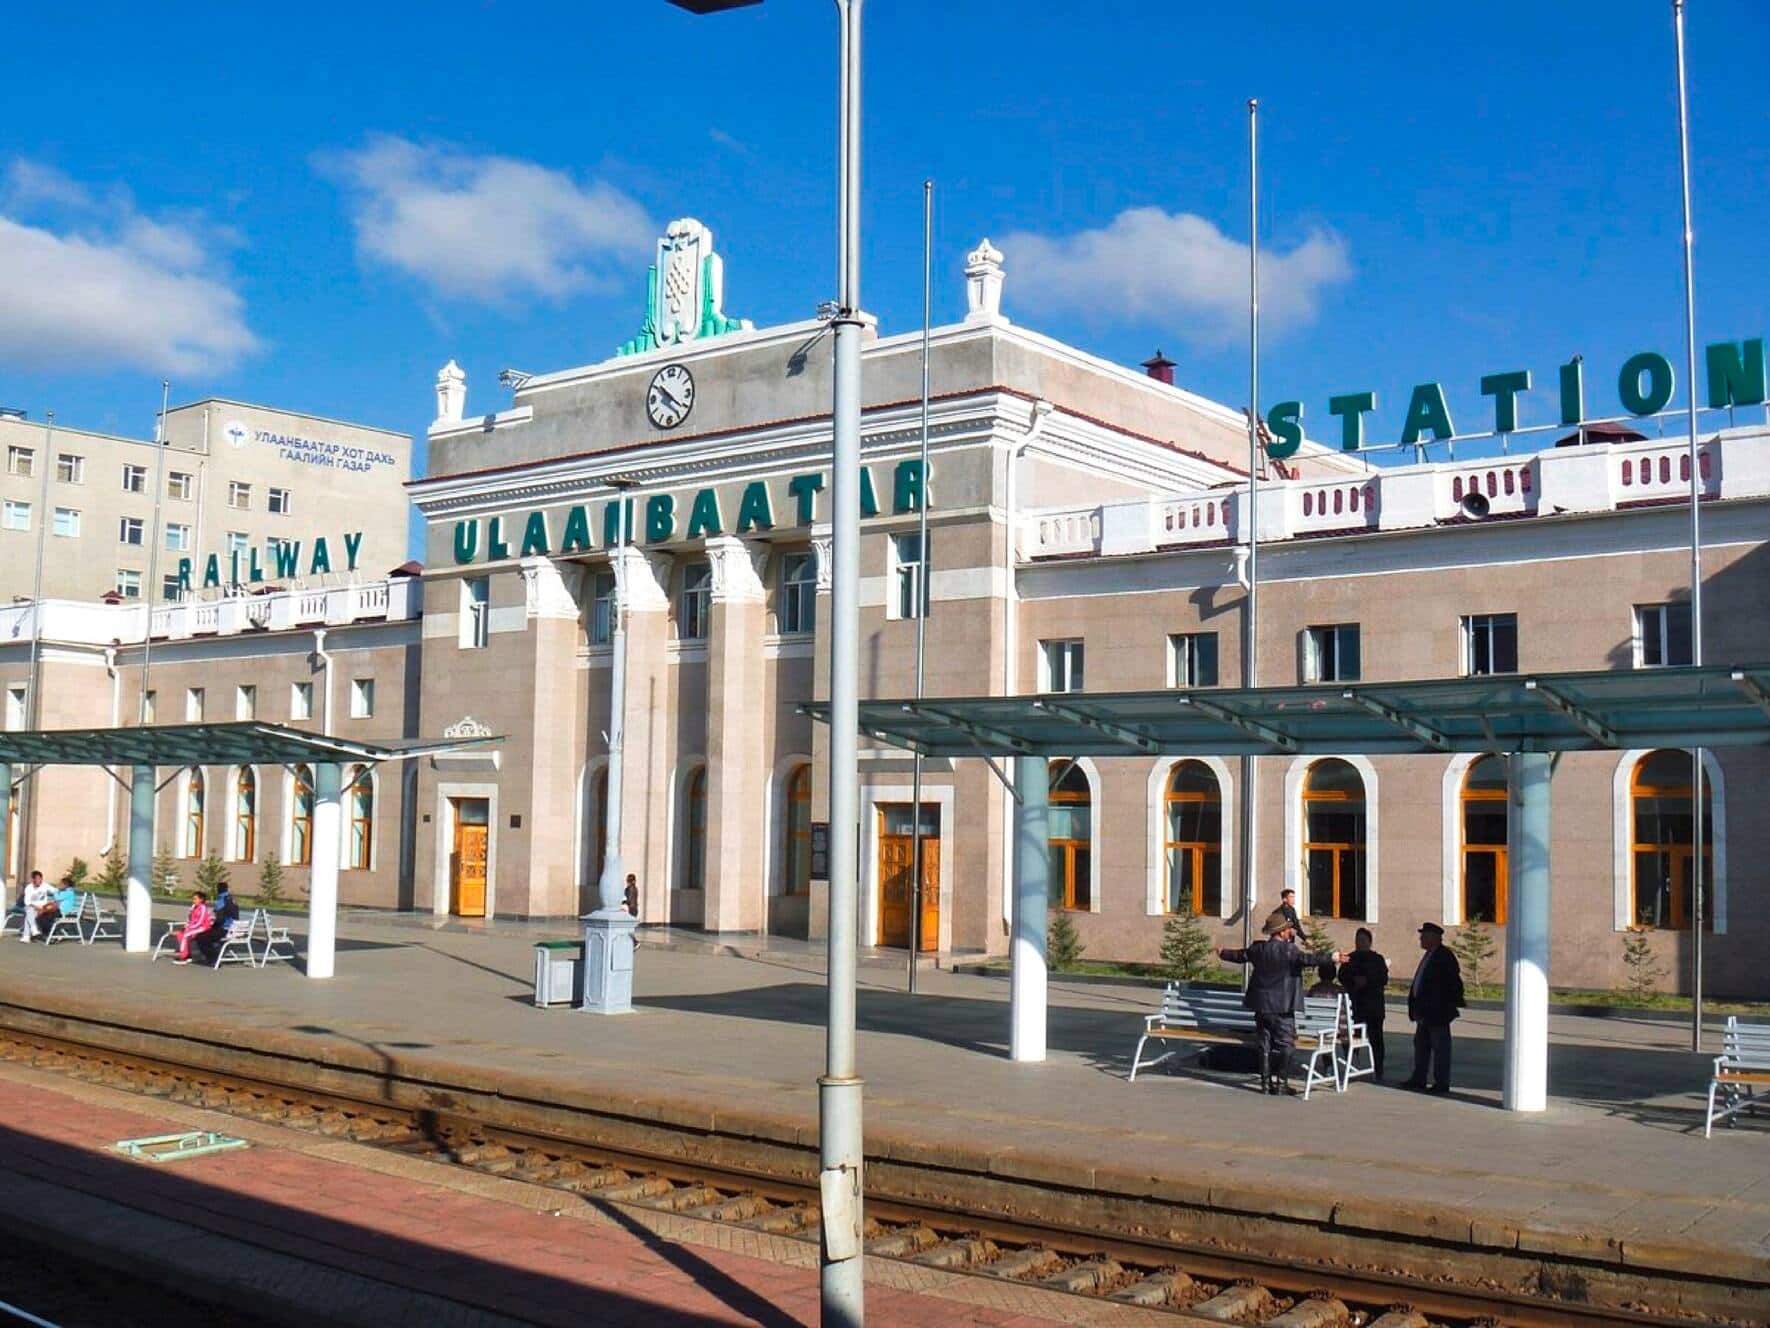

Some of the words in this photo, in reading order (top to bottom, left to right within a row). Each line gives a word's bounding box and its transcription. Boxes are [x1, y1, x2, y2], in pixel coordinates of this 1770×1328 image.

[1267, 338, 1768, 460] STATION
[254, 431, 340, 454] УЛААНБААТАР
[341, 446, 365, 459] ХОТ
[365, 451, 396, 465] ДАХЬ
[279, 448, 335, 467] ГААЛИЙН
[335, 458, 372, 473] ГАЗАР
[178, 531, 363, 592] RAILWAY
